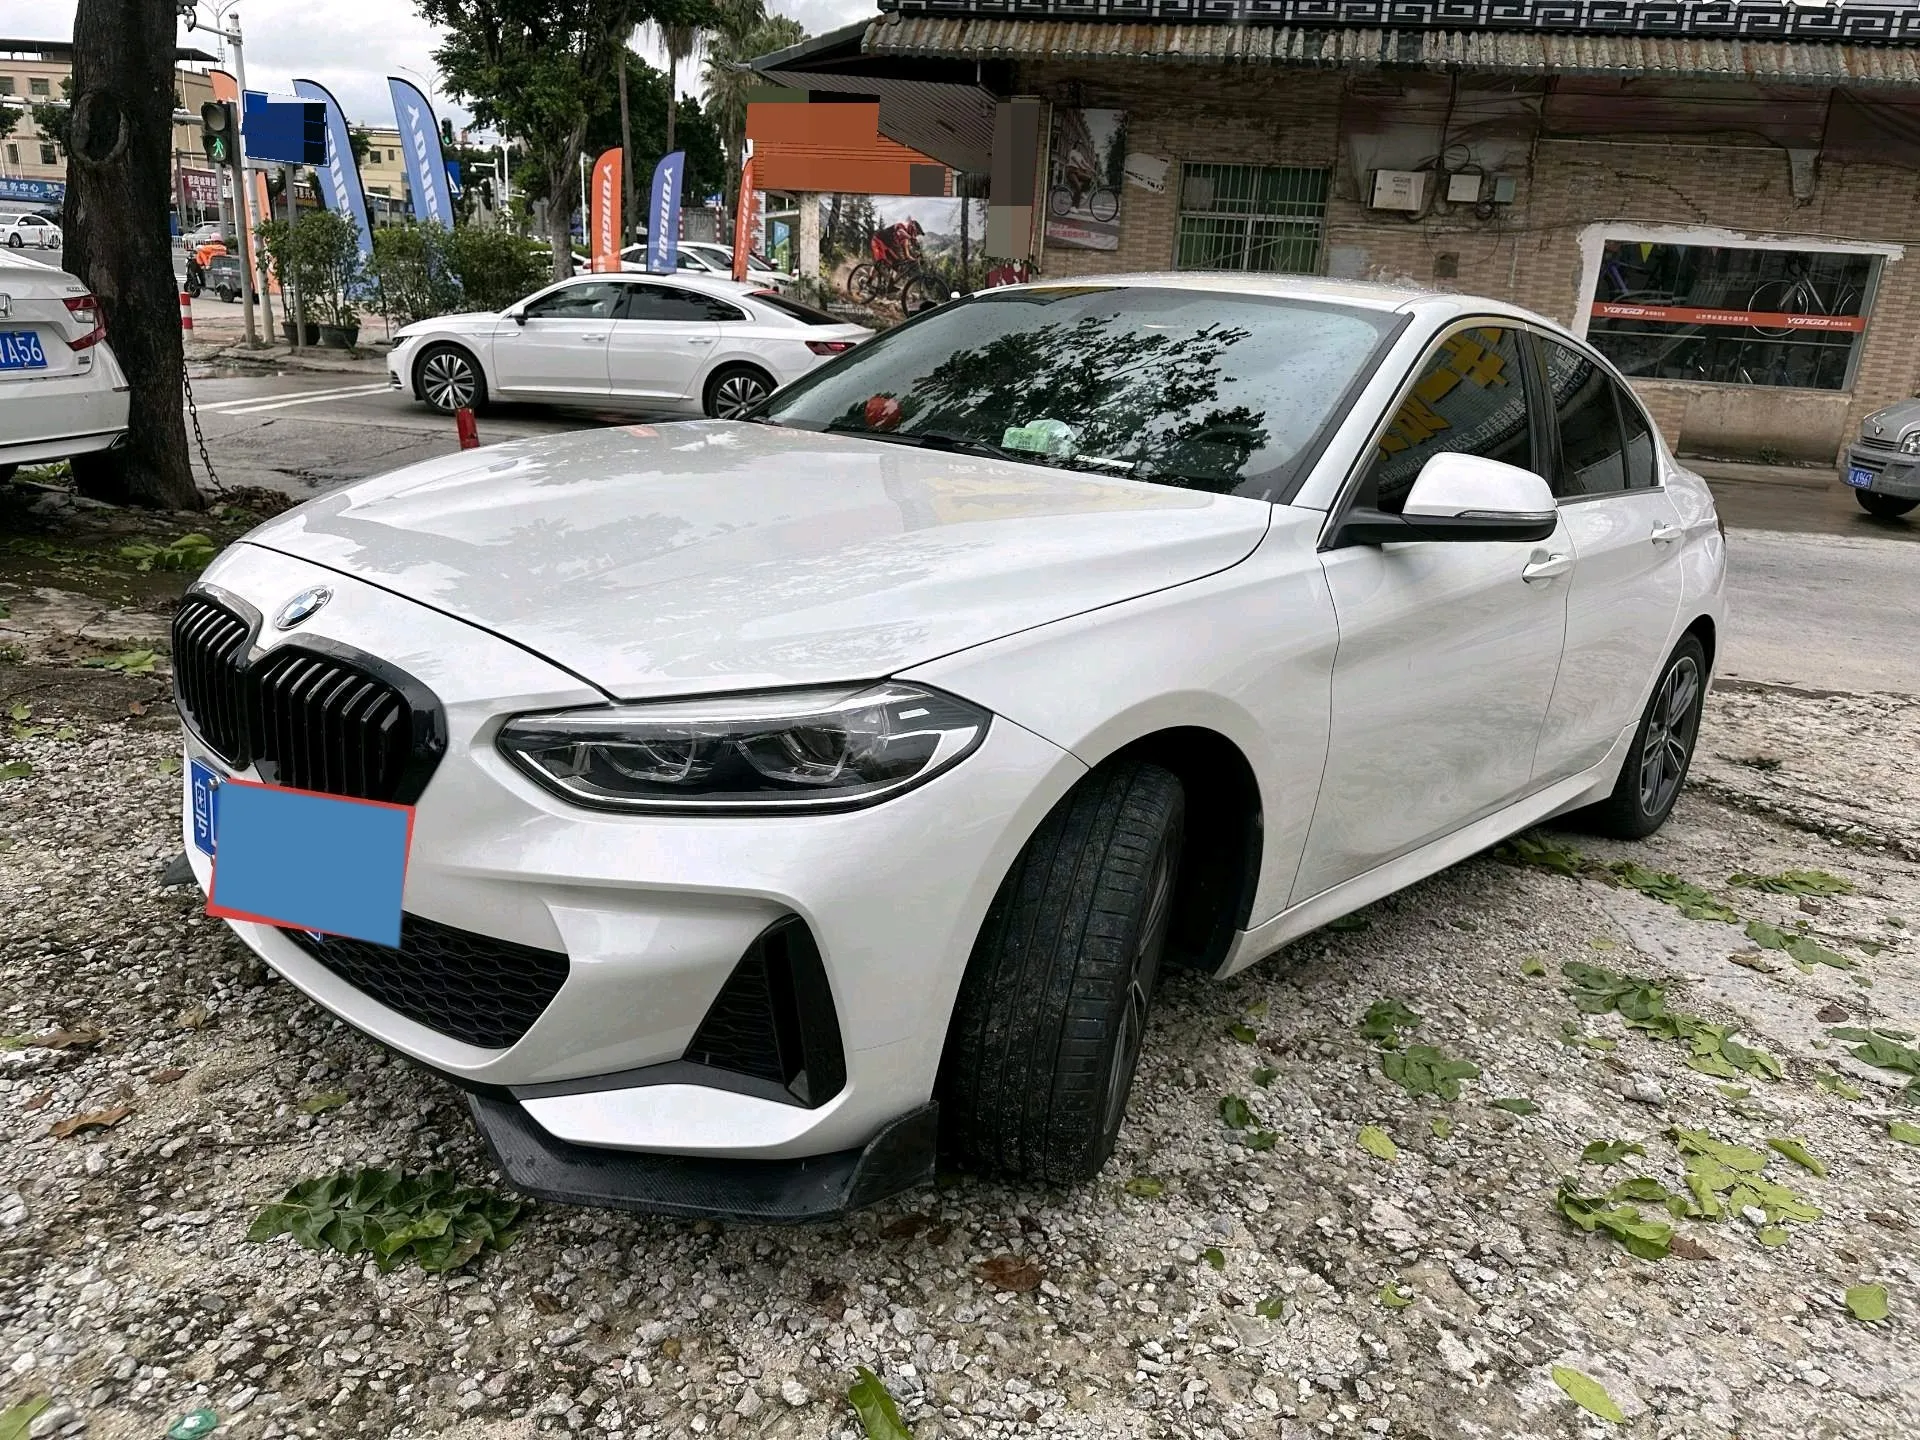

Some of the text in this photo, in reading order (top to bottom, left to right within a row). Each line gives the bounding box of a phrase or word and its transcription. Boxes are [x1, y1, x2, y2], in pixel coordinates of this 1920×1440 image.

[602, 163, 613, 256] YONGQI
[657, 166, 673, 261] YONGQI
[1603, 306, 1645, 316] YONGQI
[1787, 317, 1830, 327] YONGQI
[0, 337, 43, 363] A56
